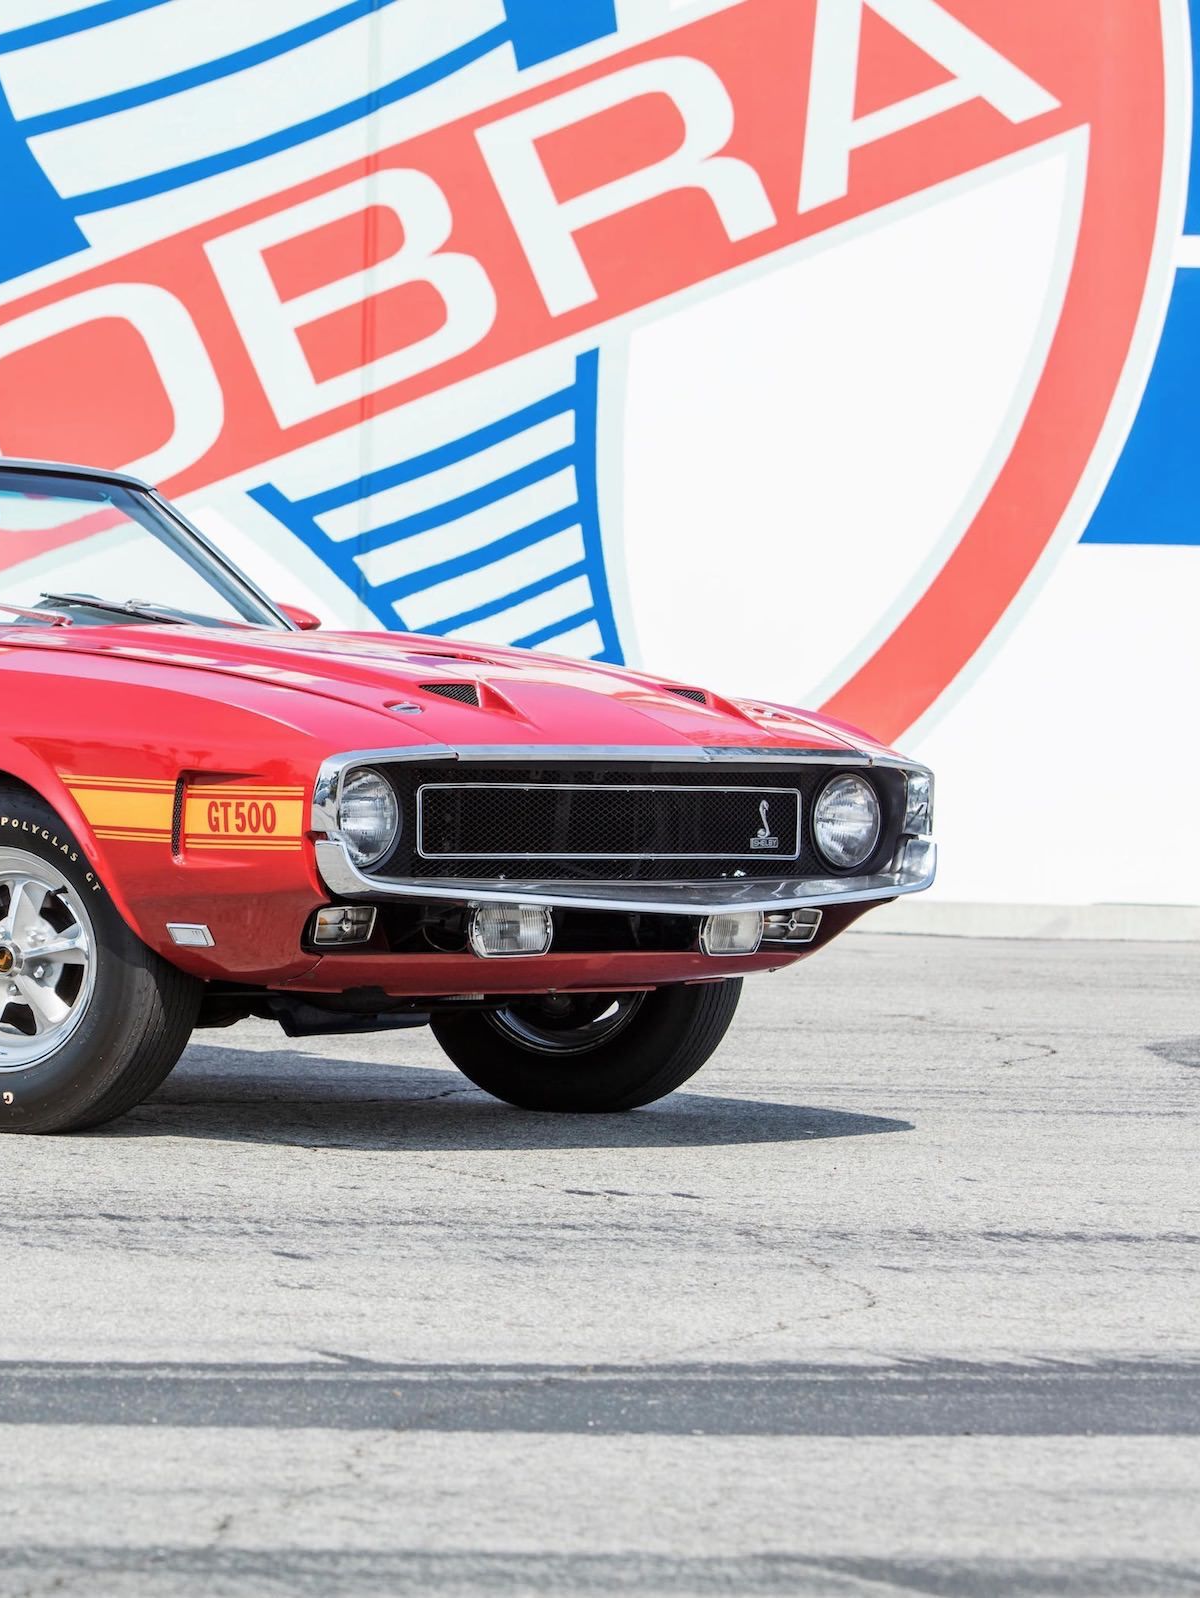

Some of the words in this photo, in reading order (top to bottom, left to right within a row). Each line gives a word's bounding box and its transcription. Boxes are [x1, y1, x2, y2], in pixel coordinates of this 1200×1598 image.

[0, 816, 79, 862] POLYGLAS
[85, 872, 101, 891] GT
[753, 839, 777, 848] SHELBY
